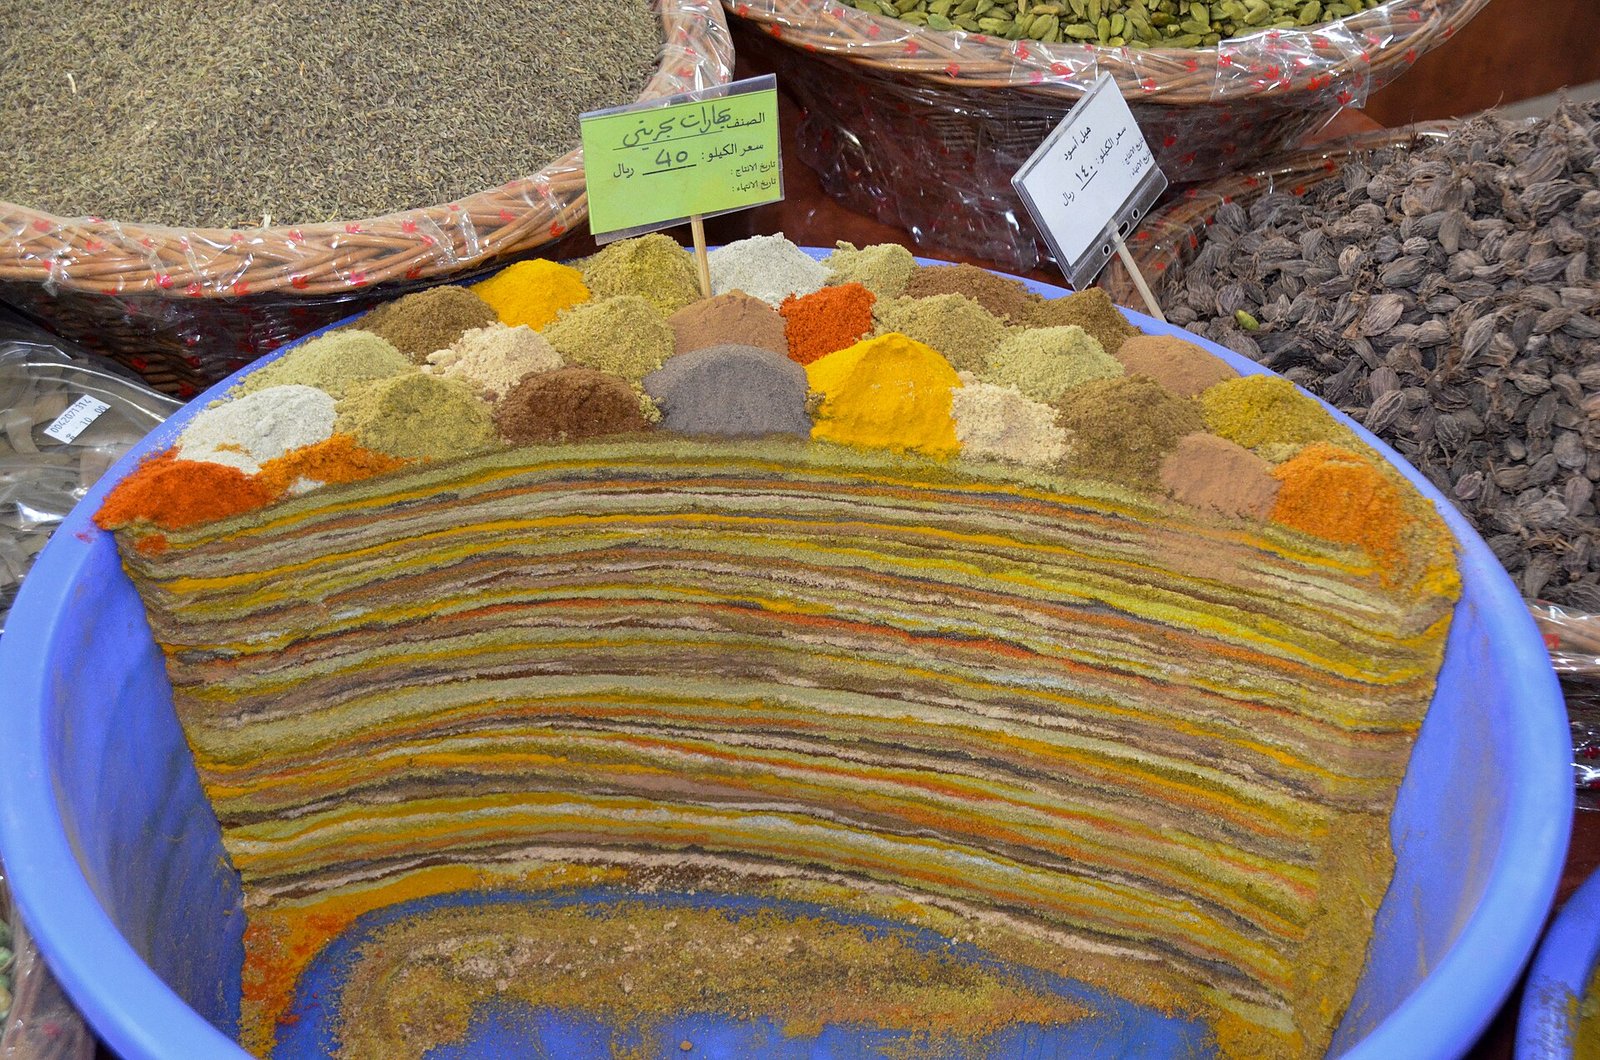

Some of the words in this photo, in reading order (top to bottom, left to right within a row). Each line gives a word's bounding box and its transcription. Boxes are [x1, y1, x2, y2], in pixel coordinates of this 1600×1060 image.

[1079, 126, 1092, 144] هيل
[1116, 127, 1127, 146] سعر
[741, 143, 764, 157] سعر
[1064, 136, 1079, 161] أسود
[613, 163, 635, 179] ريال
[759, 160, 776, 173] تاريخ
[760, 177, 777, 190] تاريخ
[1062, 191, 1075, 207] ريال
